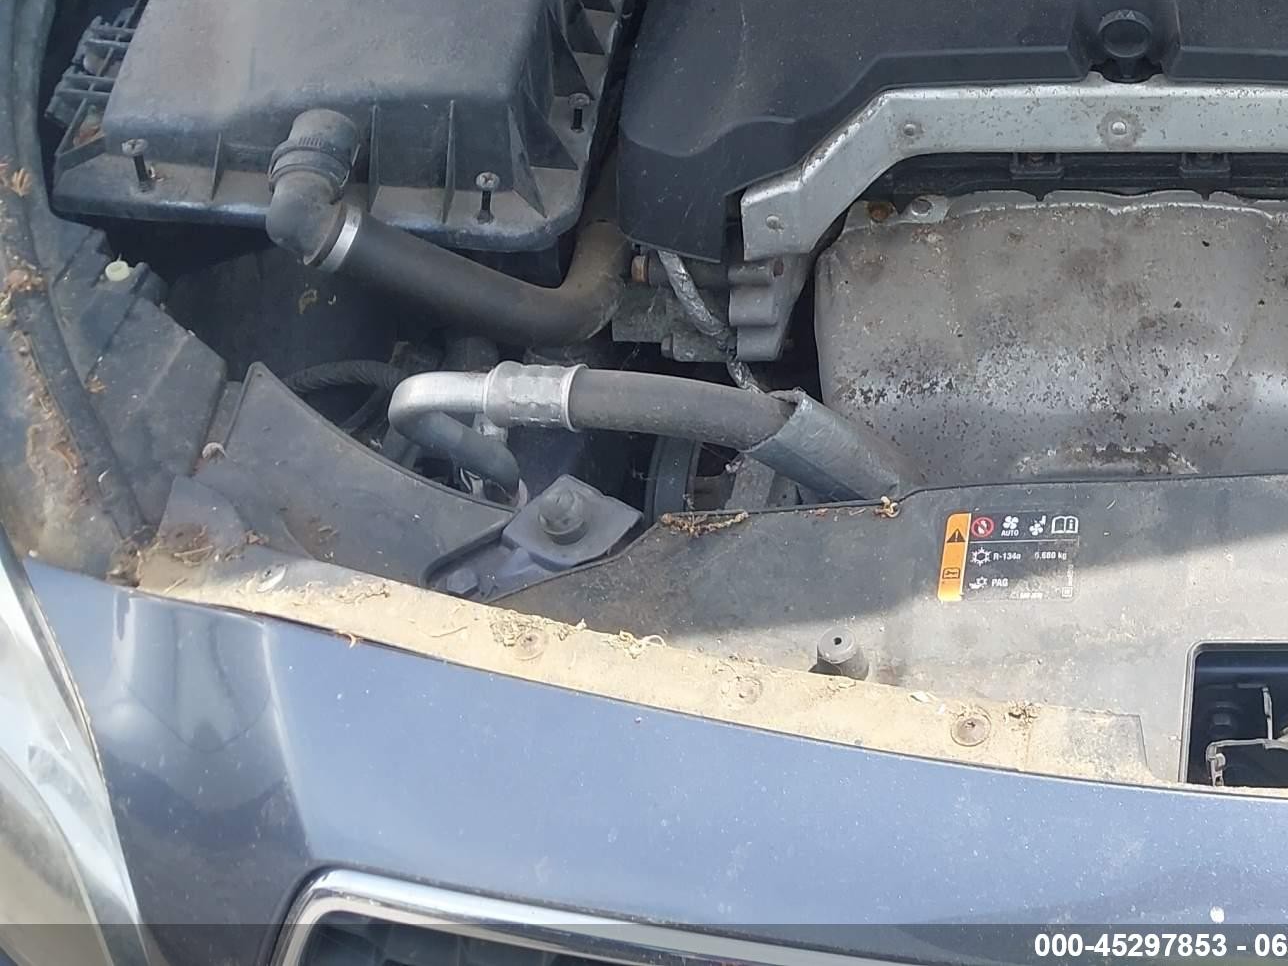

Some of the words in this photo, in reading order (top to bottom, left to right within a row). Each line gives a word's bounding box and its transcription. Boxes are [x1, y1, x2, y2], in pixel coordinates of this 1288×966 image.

[1001, 529, 1019, 537] AUTO
[993, 552, 1022, 561] R-134a
[991, 578, 1009, 587] PAG
